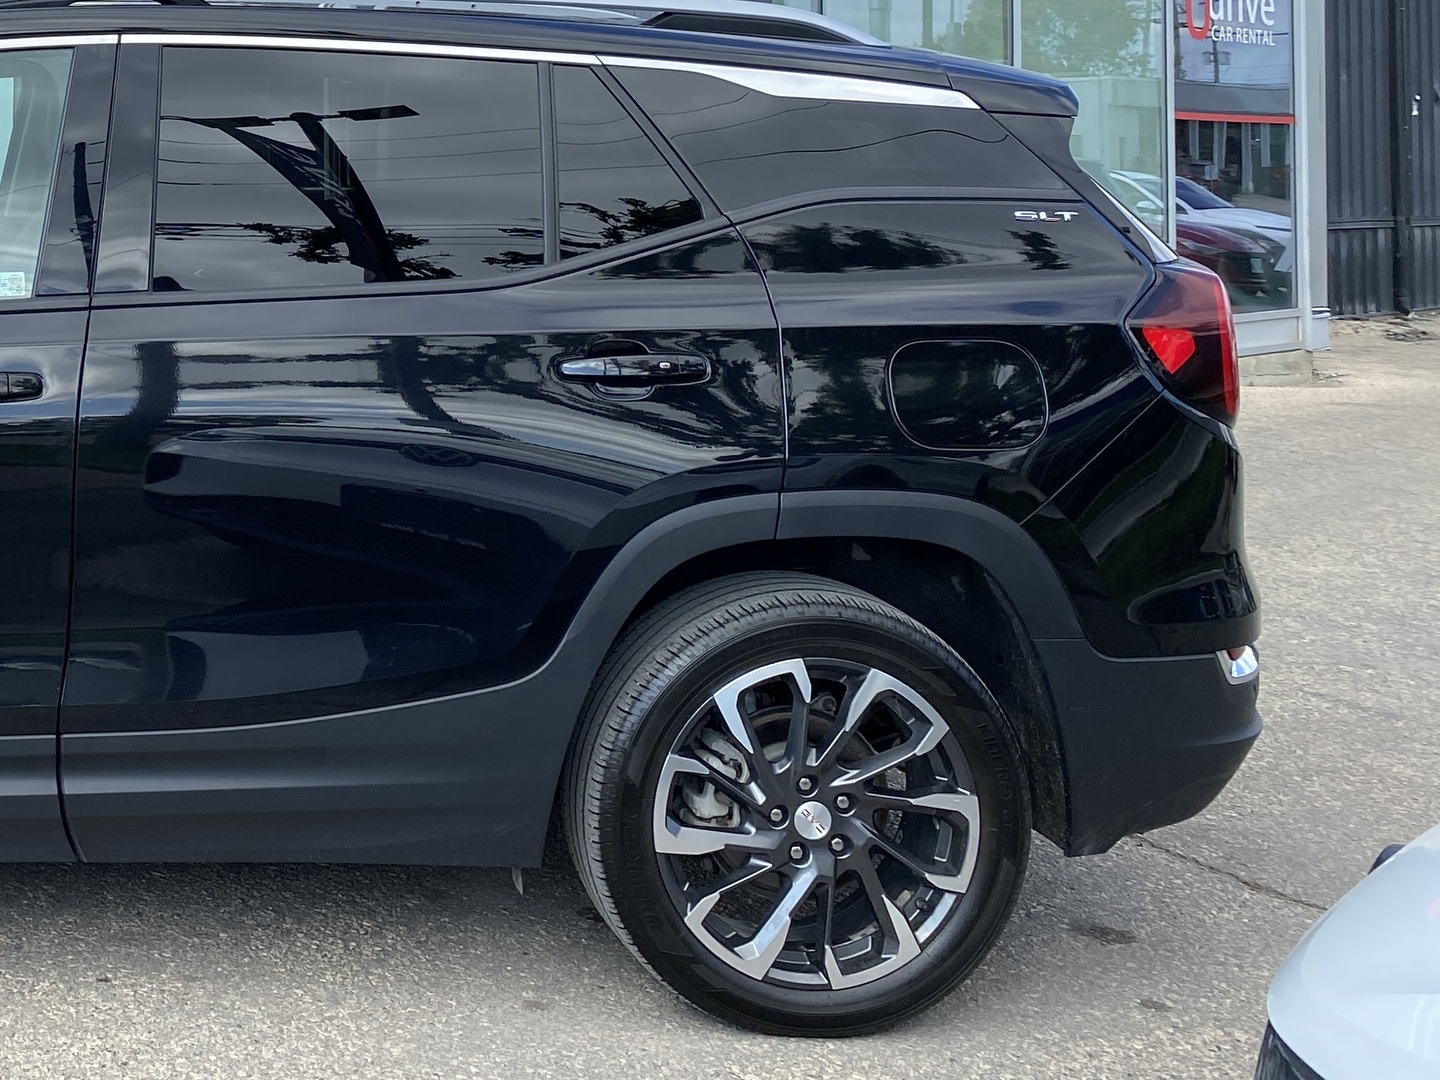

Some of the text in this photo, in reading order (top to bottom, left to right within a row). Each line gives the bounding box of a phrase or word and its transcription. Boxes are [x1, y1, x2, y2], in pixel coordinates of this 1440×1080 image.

[1211, 25, 1276, 46] CAR RENTAL
[1014, 210, 1079, 222] SLT
[801, 808, 826, 834] GMC
